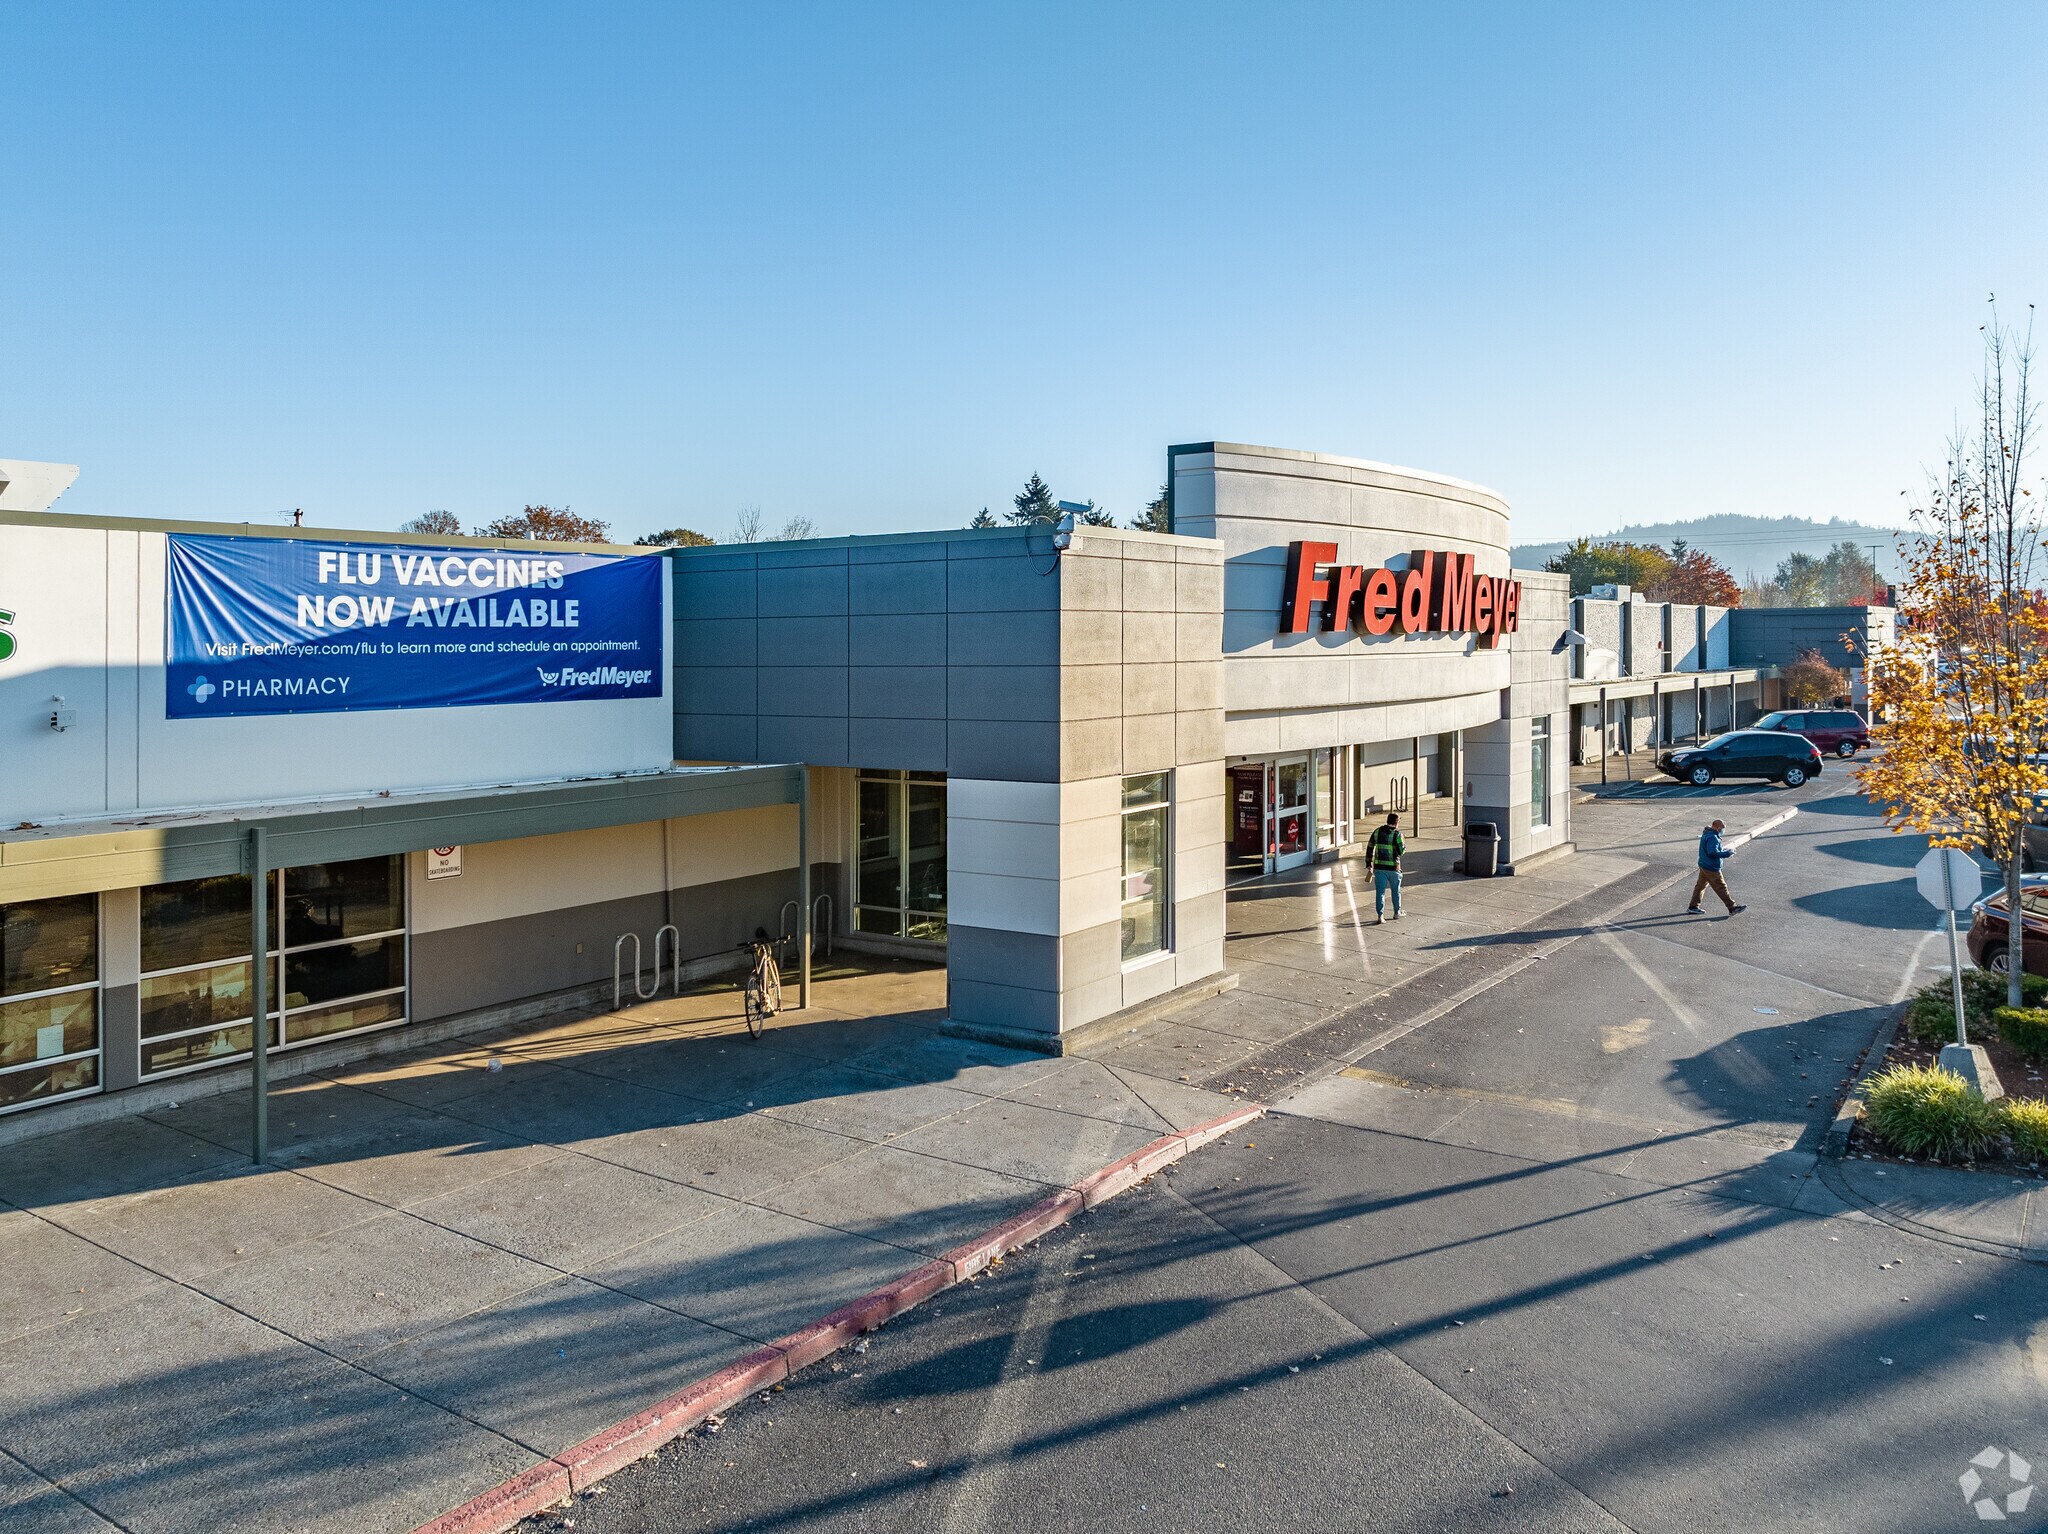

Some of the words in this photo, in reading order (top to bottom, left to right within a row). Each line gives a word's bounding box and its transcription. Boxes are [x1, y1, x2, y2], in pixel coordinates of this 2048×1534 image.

[318, 551, 381, 585] FLU
[391, 554, 564, 590] VACCINES
[1280, 541, 1435, 635] Fred
[1434, 551, 1522, 650] Meyer
[297, 595, 396, 628] NOW
[405, 597, 580, 628] AVAILABLE
[205, 642, 238, 657] Visit
[241, 642, 377, 658] FredMeyer.com/flu
[380, 641, 394, 654] to
[397, 642, 431, 654] learn
[434, 643, 467, 653] more
[469, 641, 495, 653] and
[497, 640, 551, 653] schedule
[552, 642, 568, 652] an
[570, 639, 641, 654] appointment.
[222, 676, 351, 698] PHARMACY
[429, 866, 460, 875] SKATEBOARDING
[964, 1254, 982, 1274] FIRE
